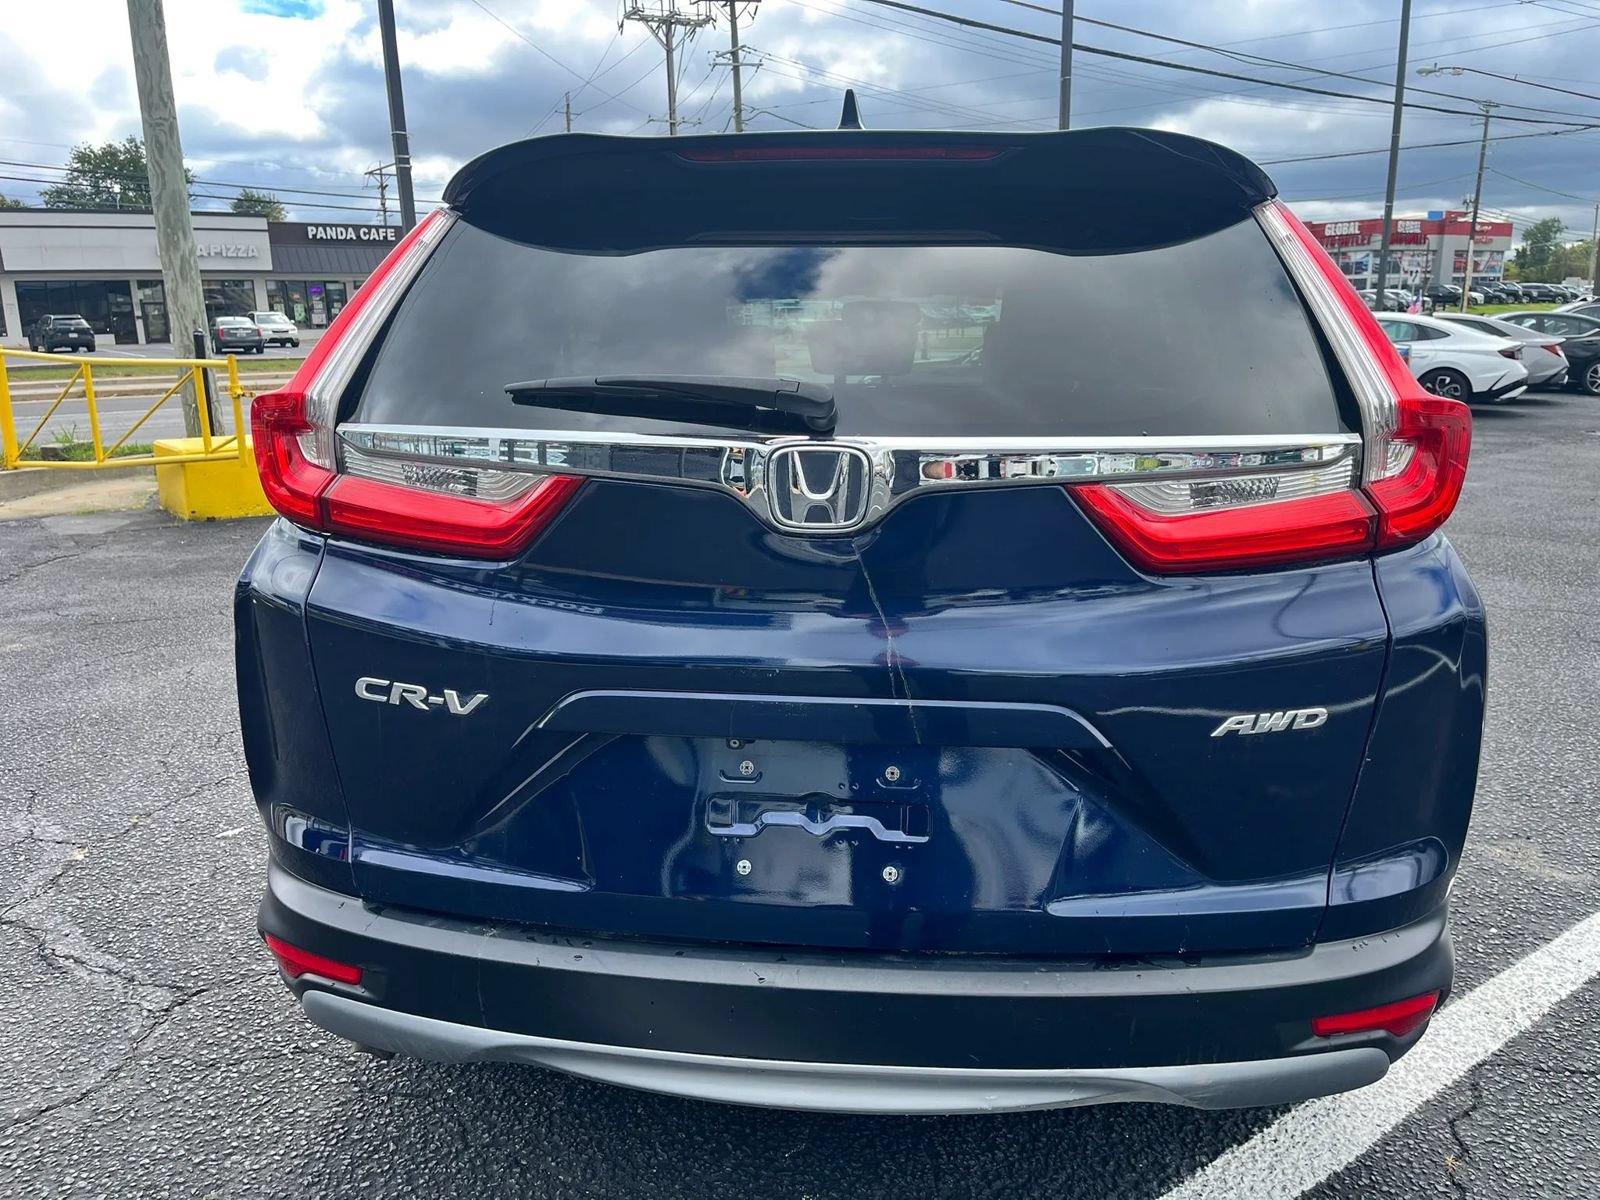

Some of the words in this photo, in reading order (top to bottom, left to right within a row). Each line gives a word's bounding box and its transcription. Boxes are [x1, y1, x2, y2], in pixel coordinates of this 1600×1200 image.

[307, 226, 357, 240] PANDA
[359, 227, 396, 241] CAFE
[1324, 222, 1361, 237] GLOBAL
[209, 243, 259, 257] PIZZA
[354, 676, 489, 715] CR-V
[1210, 707, 1329, 737] AWD
